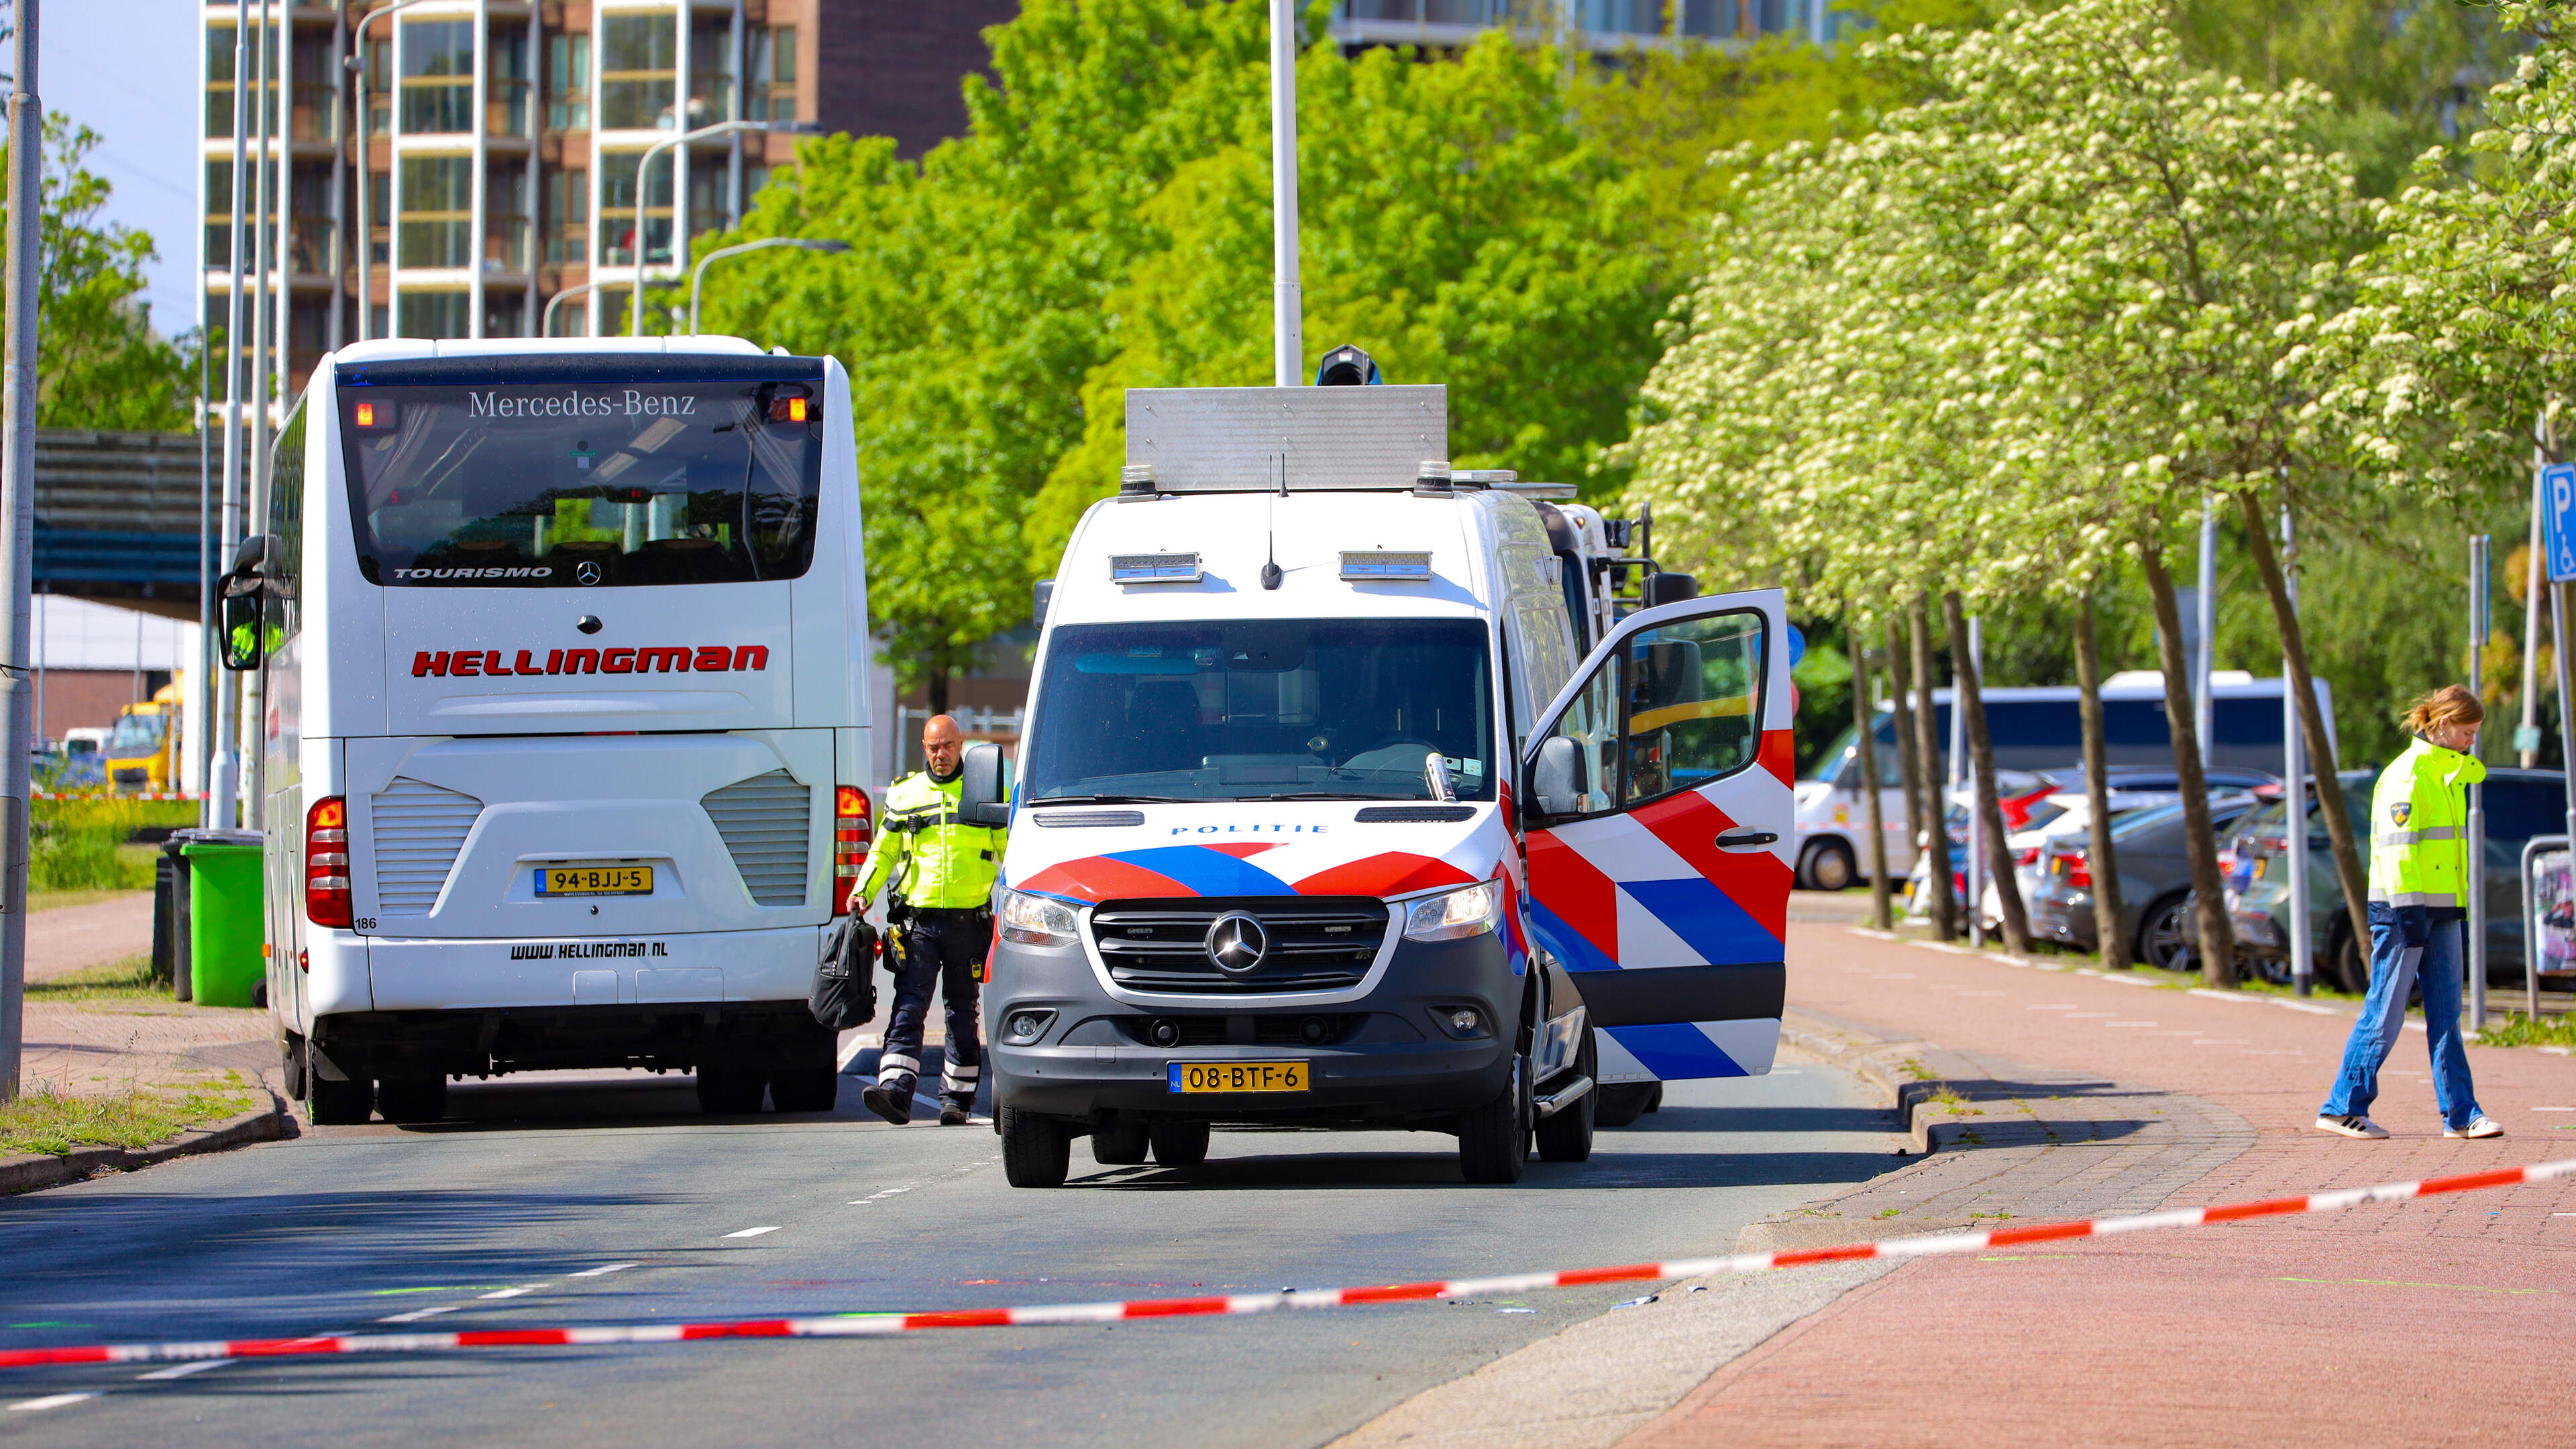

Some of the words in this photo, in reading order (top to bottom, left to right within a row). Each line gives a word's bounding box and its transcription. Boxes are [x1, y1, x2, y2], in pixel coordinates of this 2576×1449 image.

[469, 390, 696, 418] Mercedes-Benz
[2553, 476, 2571, 533] P
[394, 567, 553, 579] TOURISMO
[411, 645, 769, 678] HELLINGMAN
[1171, 824, 1328, 835] POLITIE
[555, 871, 641, 889] 94-BJJ-5
[356, 918, 377, 929] 186
[1189, 1067, 1298, 1088] 08-BTF-6
